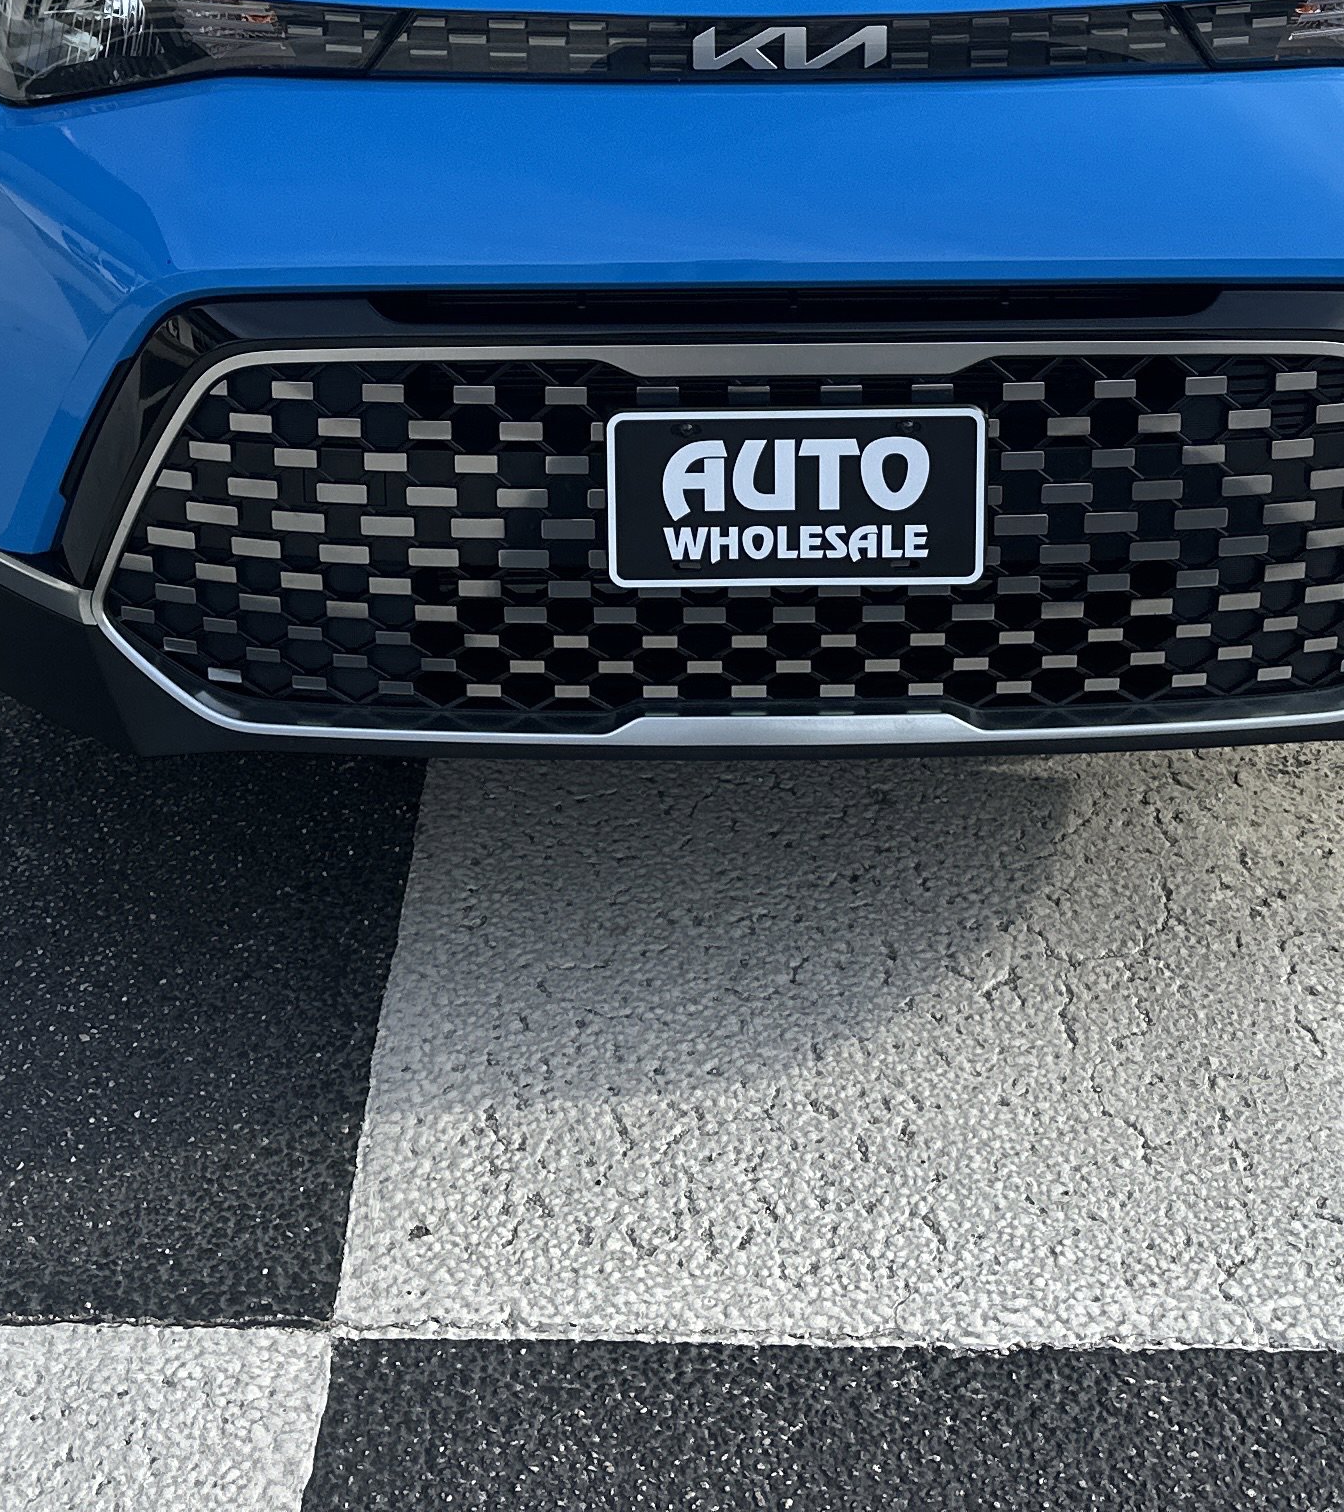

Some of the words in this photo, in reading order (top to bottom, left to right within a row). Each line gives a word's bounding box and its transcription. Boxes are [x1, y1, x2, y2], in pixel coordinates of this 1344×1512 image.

[692, 25, 888, 70] KIA
[663, 436, 930, 521] AUTO
[663, 524, 929, 564] WHOLESALE
